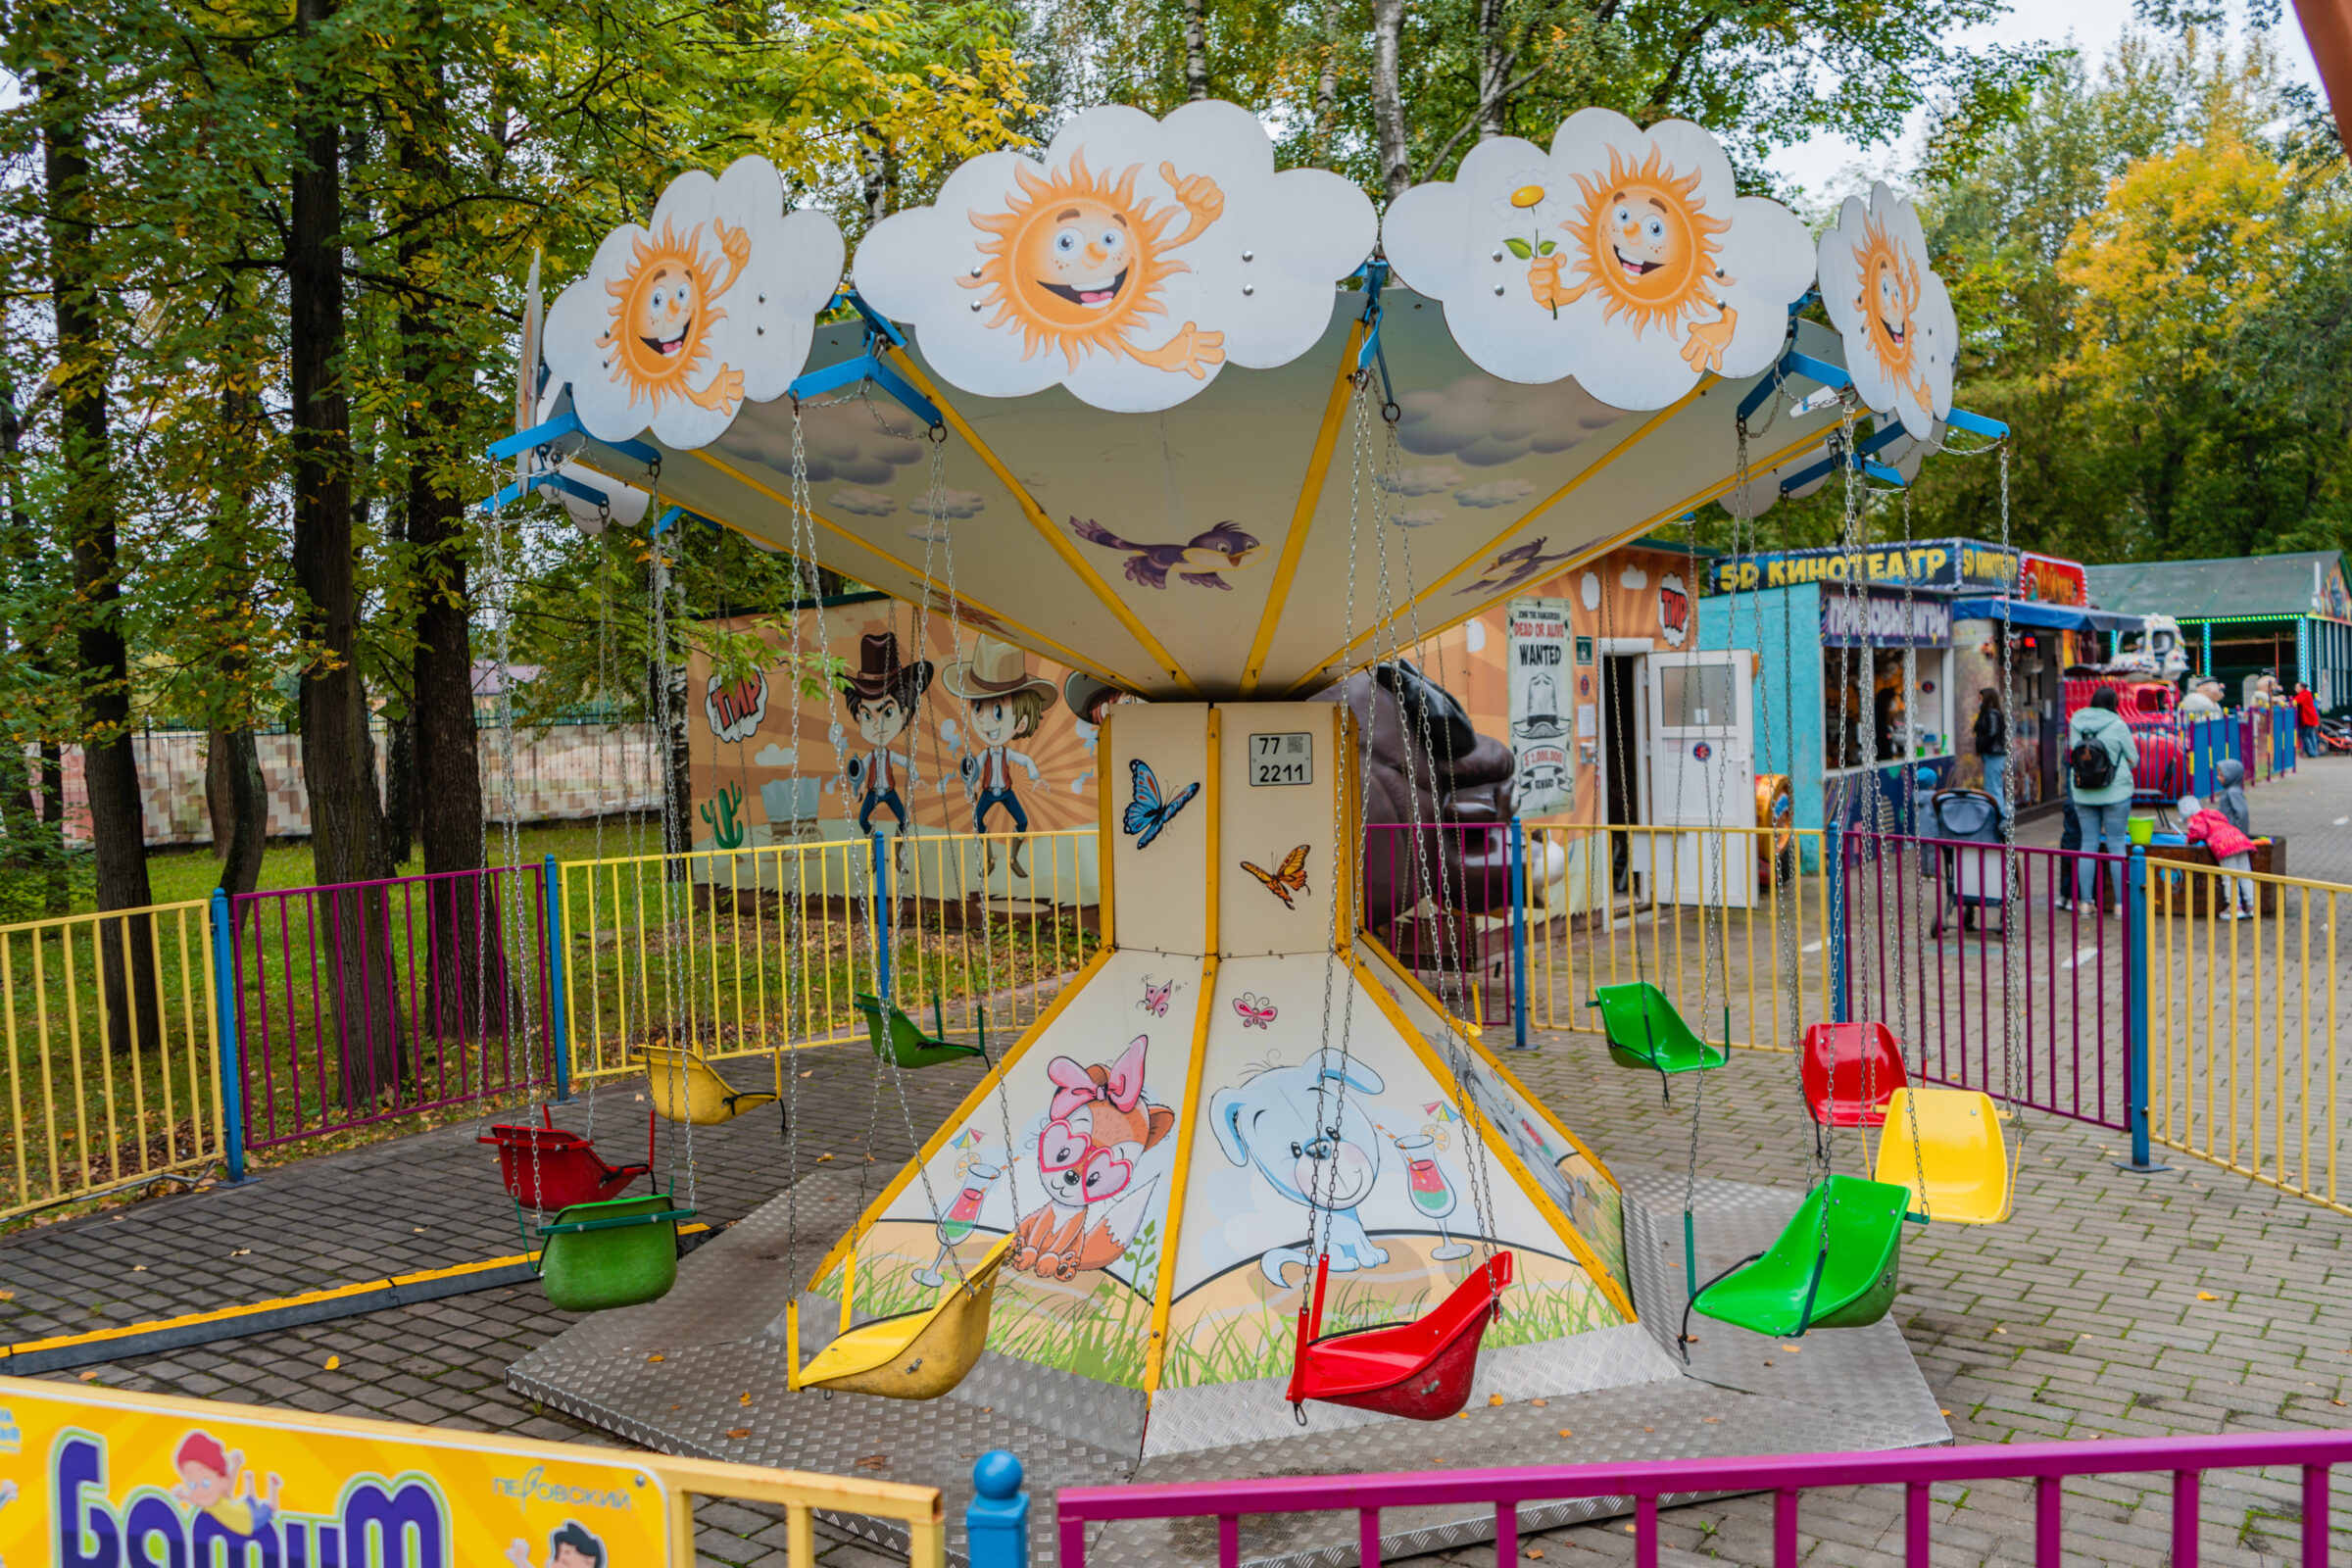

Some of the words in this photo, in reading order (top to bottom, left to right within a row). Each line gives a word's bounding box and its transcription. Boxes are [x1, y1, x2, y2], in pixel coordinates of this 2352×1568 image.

[1720, 562, 1760, 591] 5D
[1767, 548, 1947, 588] КИНОТЕАТР
[1661, 587, 1688, 633] ТИР
[1830, 595, 1912, 636] ПРИОВЫ
[1913, 601, 1949, 637] ИГРЫ
[1514, 622, 1533, 637] DEAD
[1536, 622, 1544, 637] OR
[1546, 623, 1565, 638] ALIVE
[1519, 644, 1561, 665] WANTED
[710, 671, 761, 731] ТИР
[1259, 737, 1280, 755] 77
[1259, 763, 1303, 782] 2211
